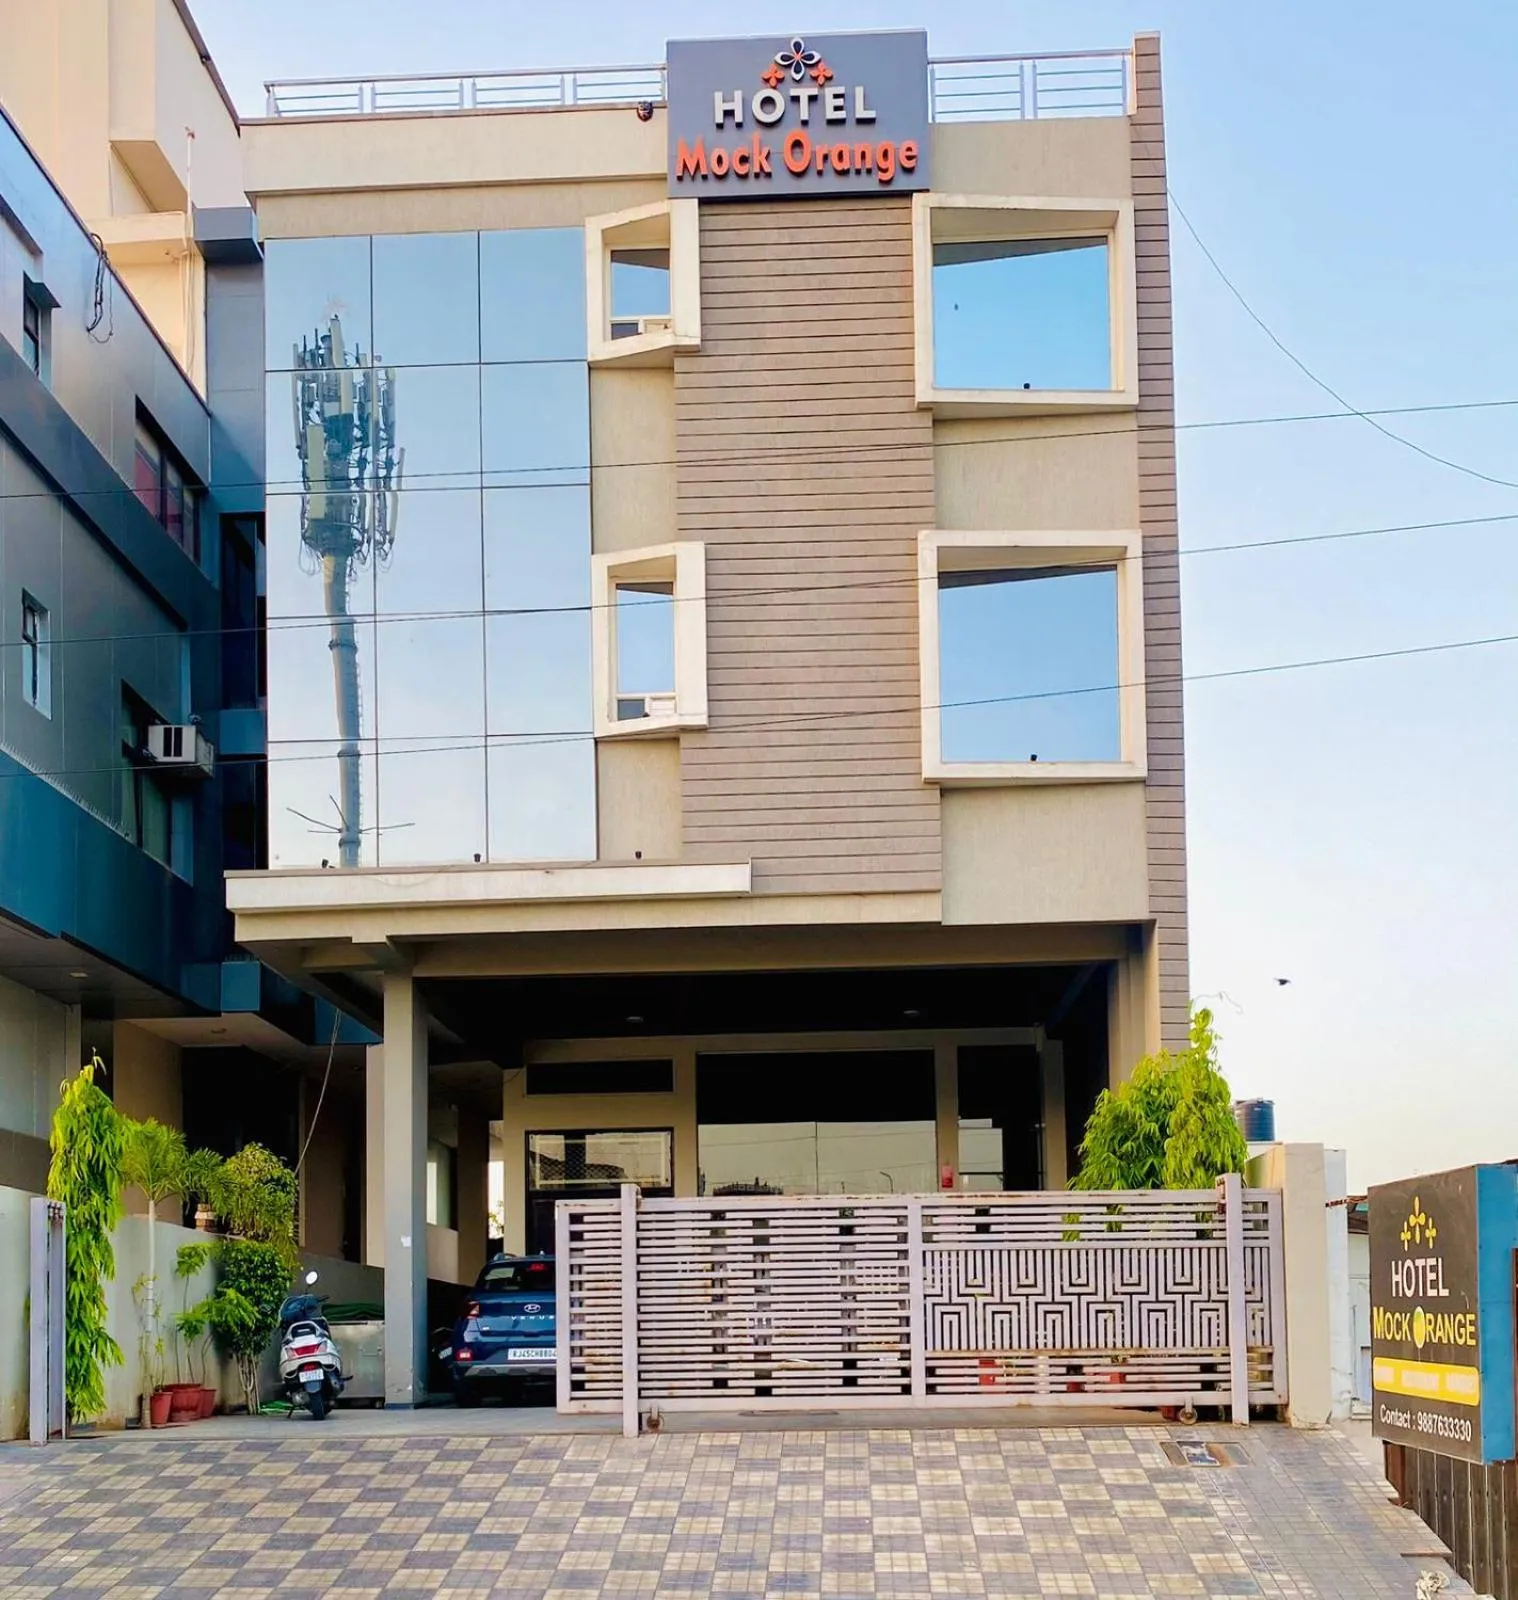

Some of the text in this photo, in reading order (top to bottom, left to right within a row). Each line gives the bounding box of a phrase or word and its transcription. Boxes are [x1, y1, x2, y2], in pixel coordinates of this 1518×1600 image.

[713, 86, 877, 126] HOTEL
[676, 128, 919, 183] Mock Orange
[1392, 1257, 1450, 1298] HOTEL
[1373, 1306, 1412, 1341] MOCK
[1380, 1404, 1411, 1429] Contact
[1417, 1411, 1472, 1442] 9887633330
